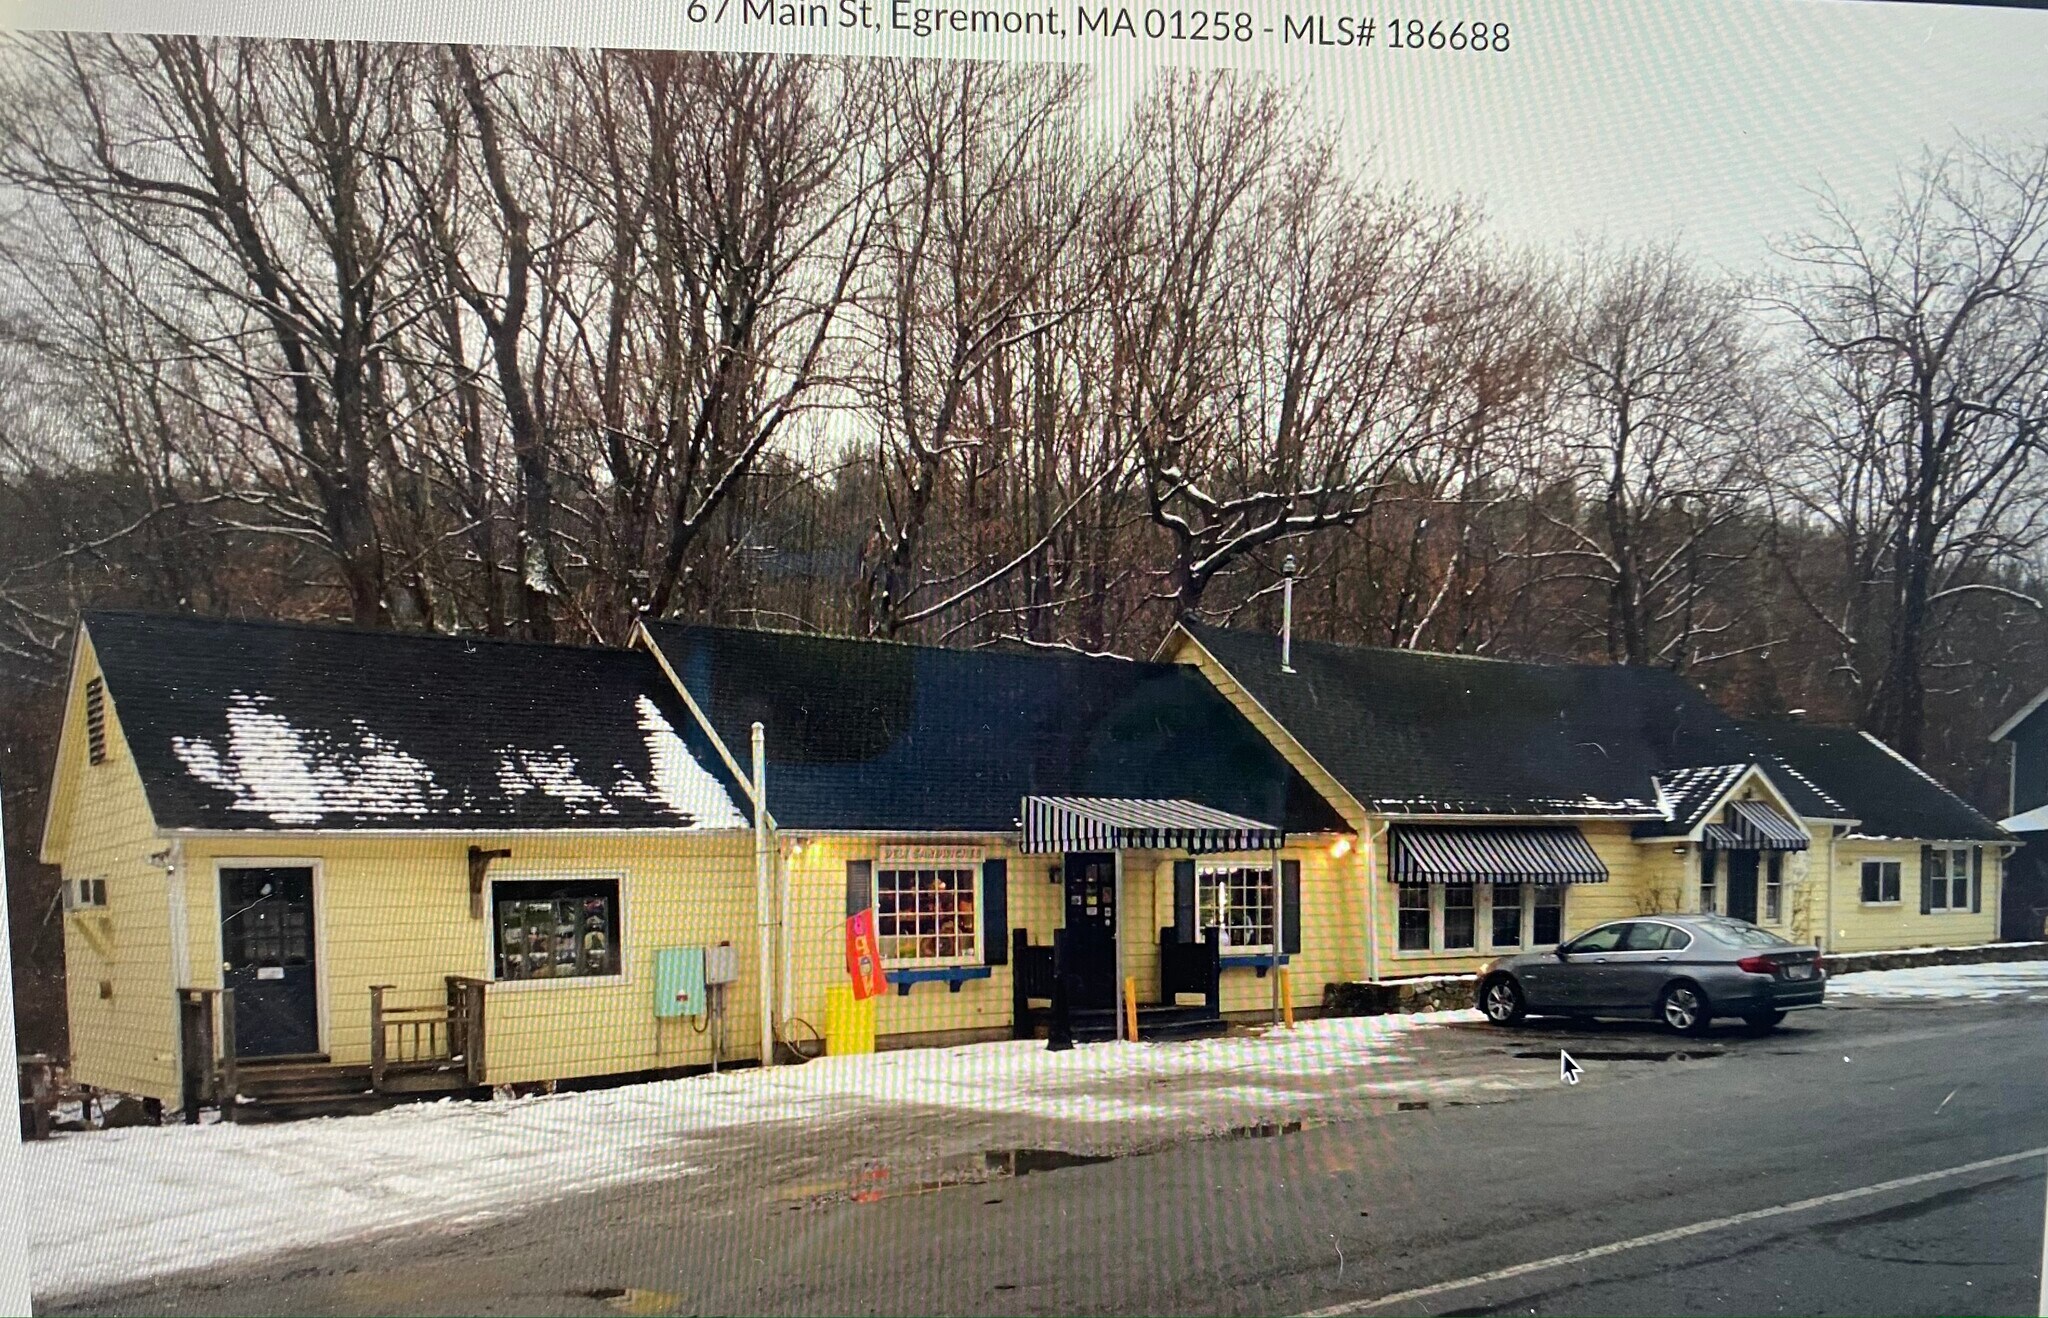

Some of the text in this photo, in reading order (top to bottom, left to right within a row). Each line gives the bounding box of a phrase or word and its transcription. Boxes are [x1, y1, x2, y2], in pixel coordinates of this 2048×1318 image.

[743, 0, 828, 27] Main
[838, 0, 881, 32] St,
[891, 0, 1066, 39] Egremont,
[1077, 6, 1136, 37] MA
[1144, 8, 1253, 42] 01258
[1284, 14, 1376, 47] MLS#
[1387, 18, 1511, 52] 186688
